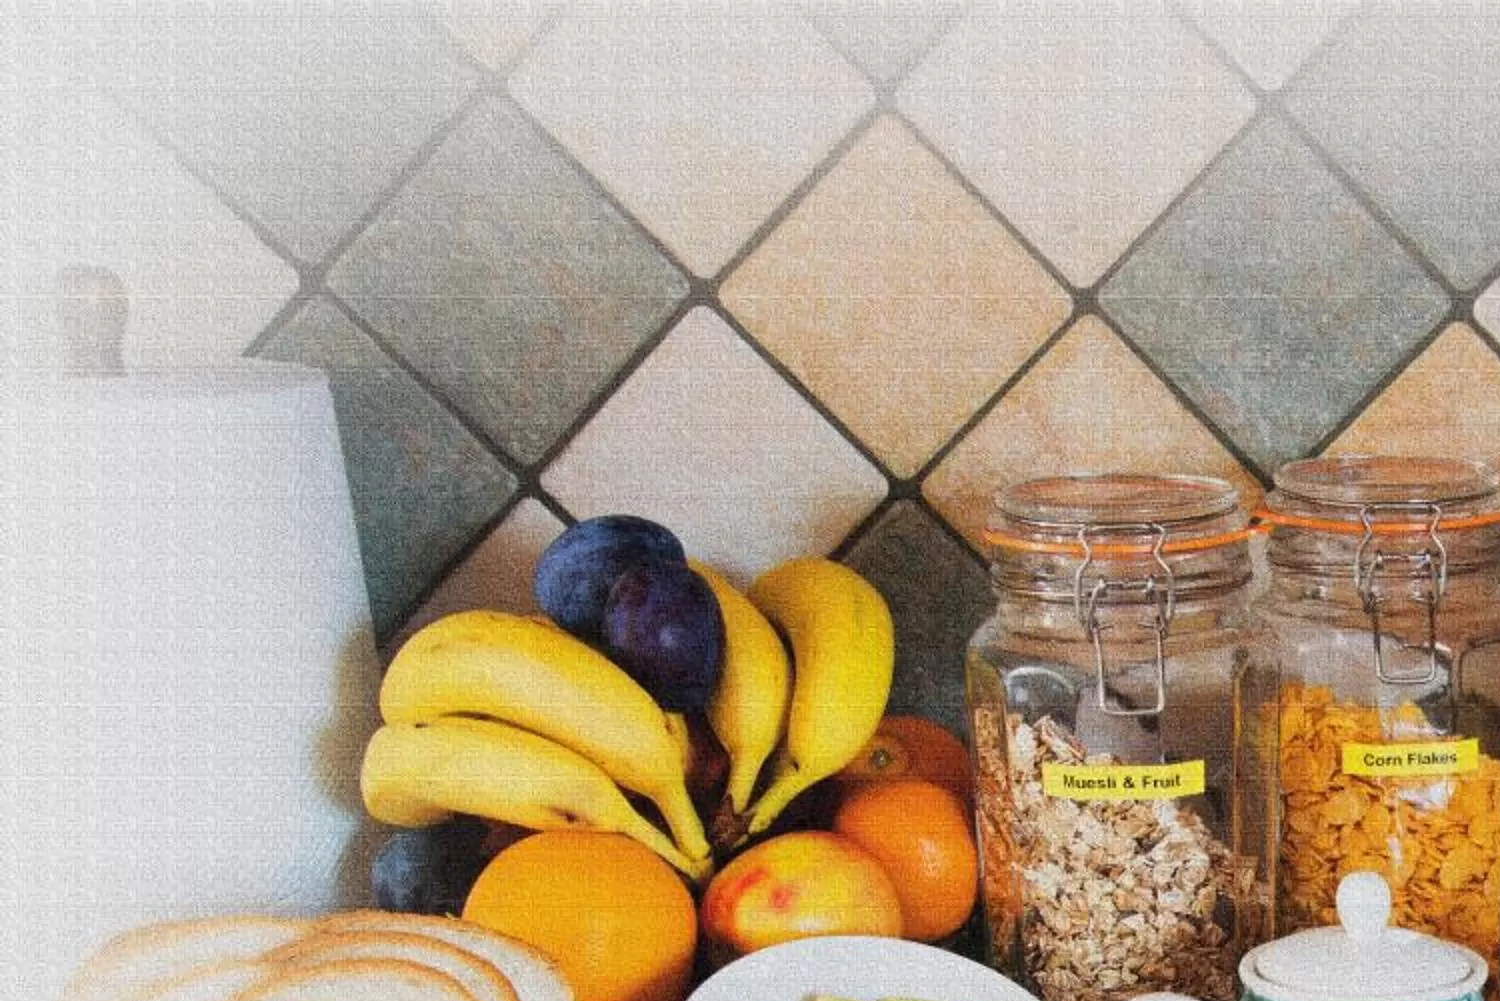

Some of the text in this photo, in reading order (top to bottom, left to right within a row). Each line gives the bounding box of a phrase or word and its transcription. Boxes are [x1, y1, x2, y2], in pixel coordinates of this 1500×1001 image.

[1362, 751, 1458, 768] Corn Flakes
[1062, 774, 1182, 790] Muesli & Fruit
